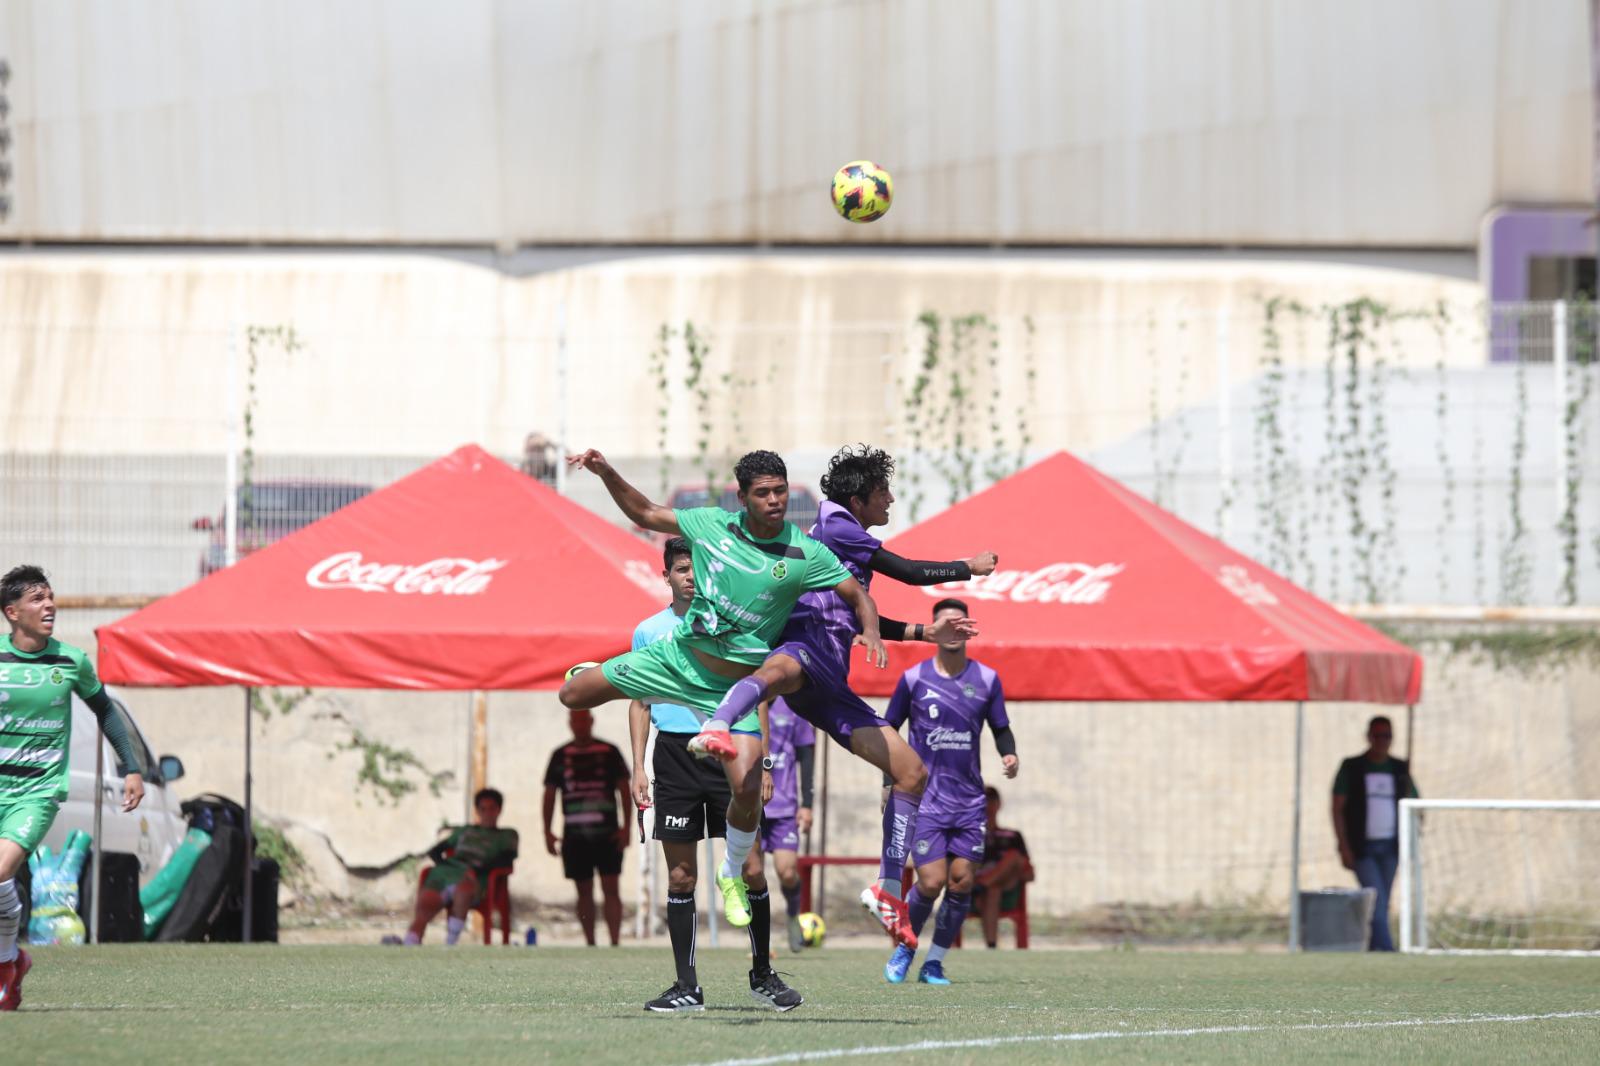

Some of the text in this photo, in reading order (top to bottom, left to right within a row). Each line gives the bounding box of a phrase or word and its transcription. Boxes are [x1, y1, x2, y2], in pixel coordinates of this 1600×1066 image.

[306, 551, 509, 596] Coca-Cola
[923, 568, 956, 577] PIRMA
[928, 703, 939, 719] 6
[665, 815, 690, 828] FMF
